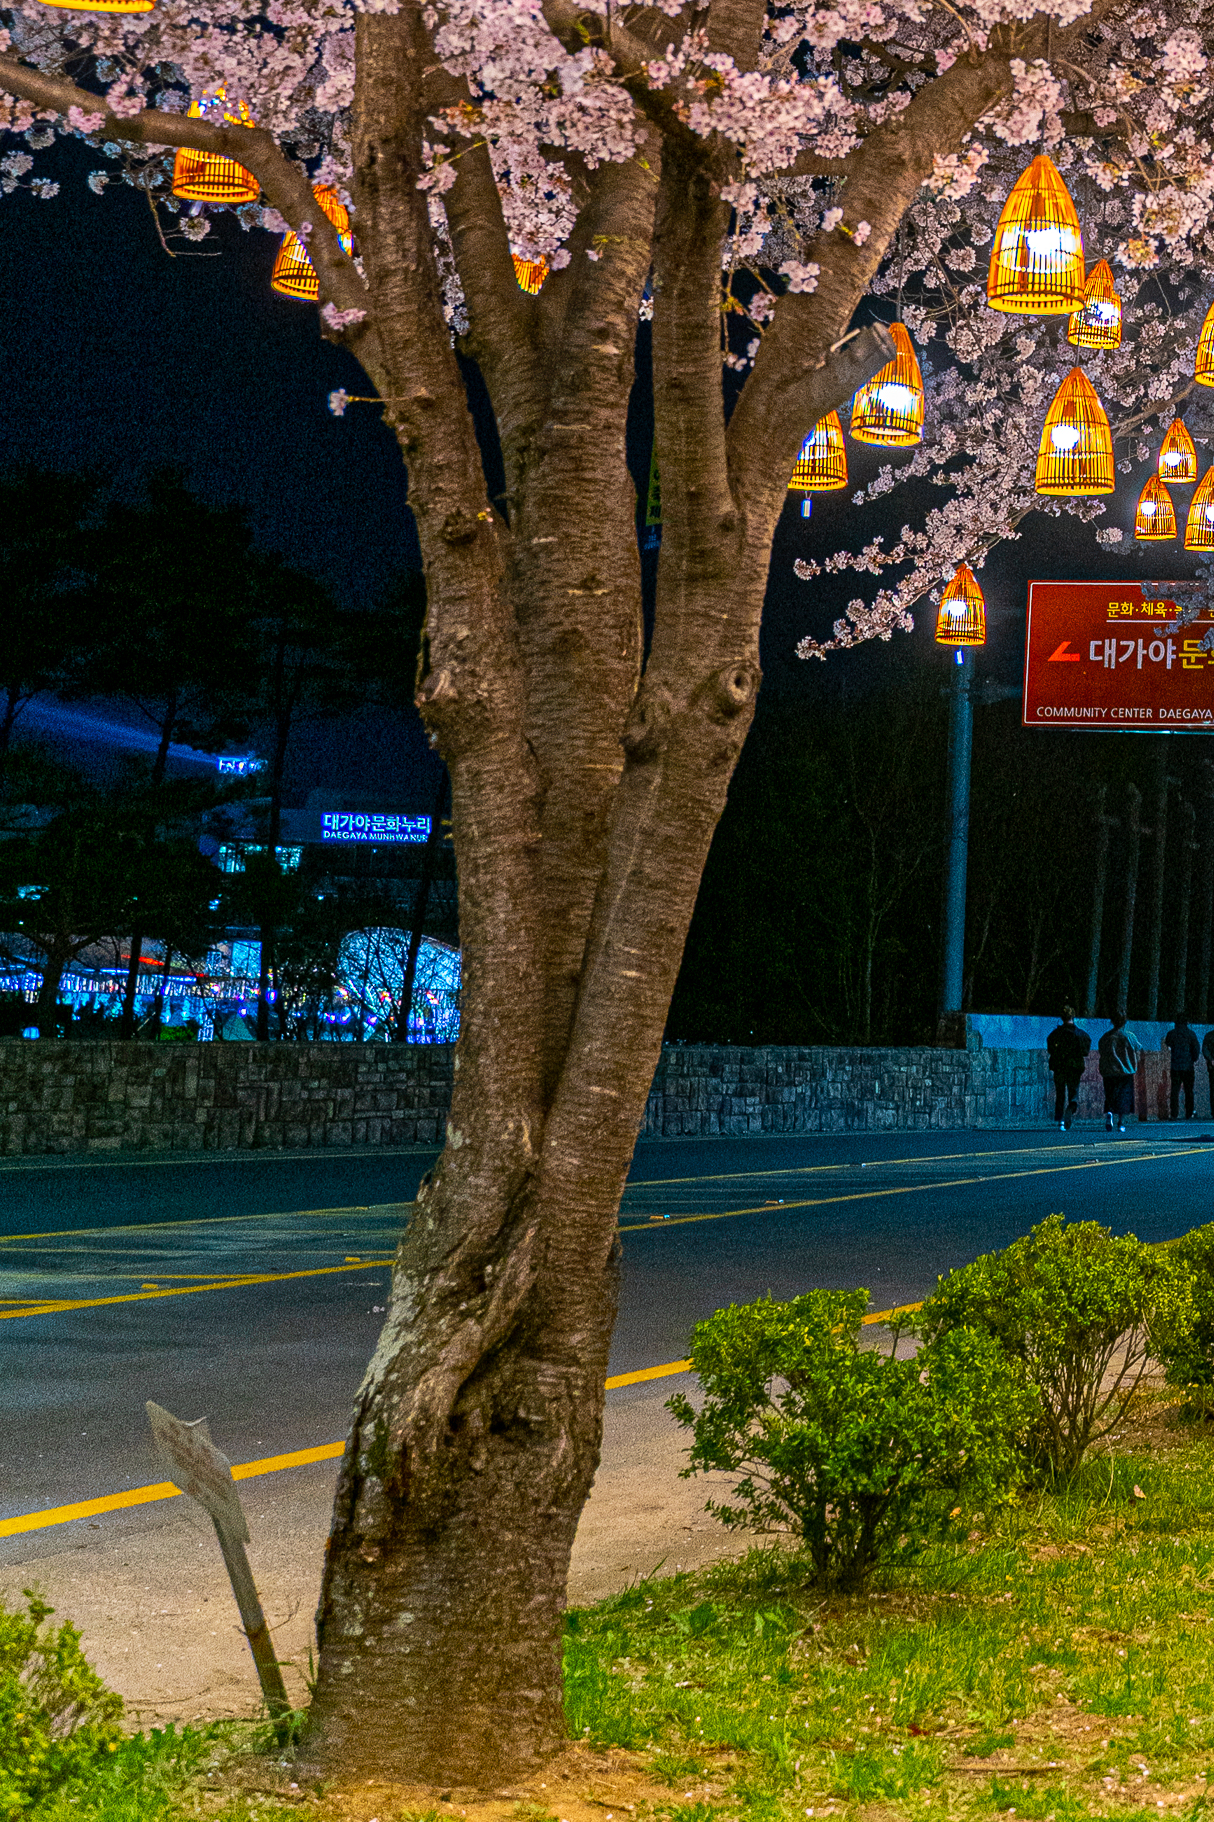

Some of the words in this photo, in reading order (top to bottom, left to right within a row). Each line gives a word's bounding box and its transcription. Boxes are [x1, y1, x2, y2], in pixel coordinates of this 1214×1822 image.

[1036, 706, 1108, 718] COMMUNITY
[1110, 707, 1153, 719] CENTER
[1159, 708, 1213, 720] DAEGAYA
[323, 814, 431, 834] 대가야문화누리
[323, 830, 368, 840] DAEGAYA
